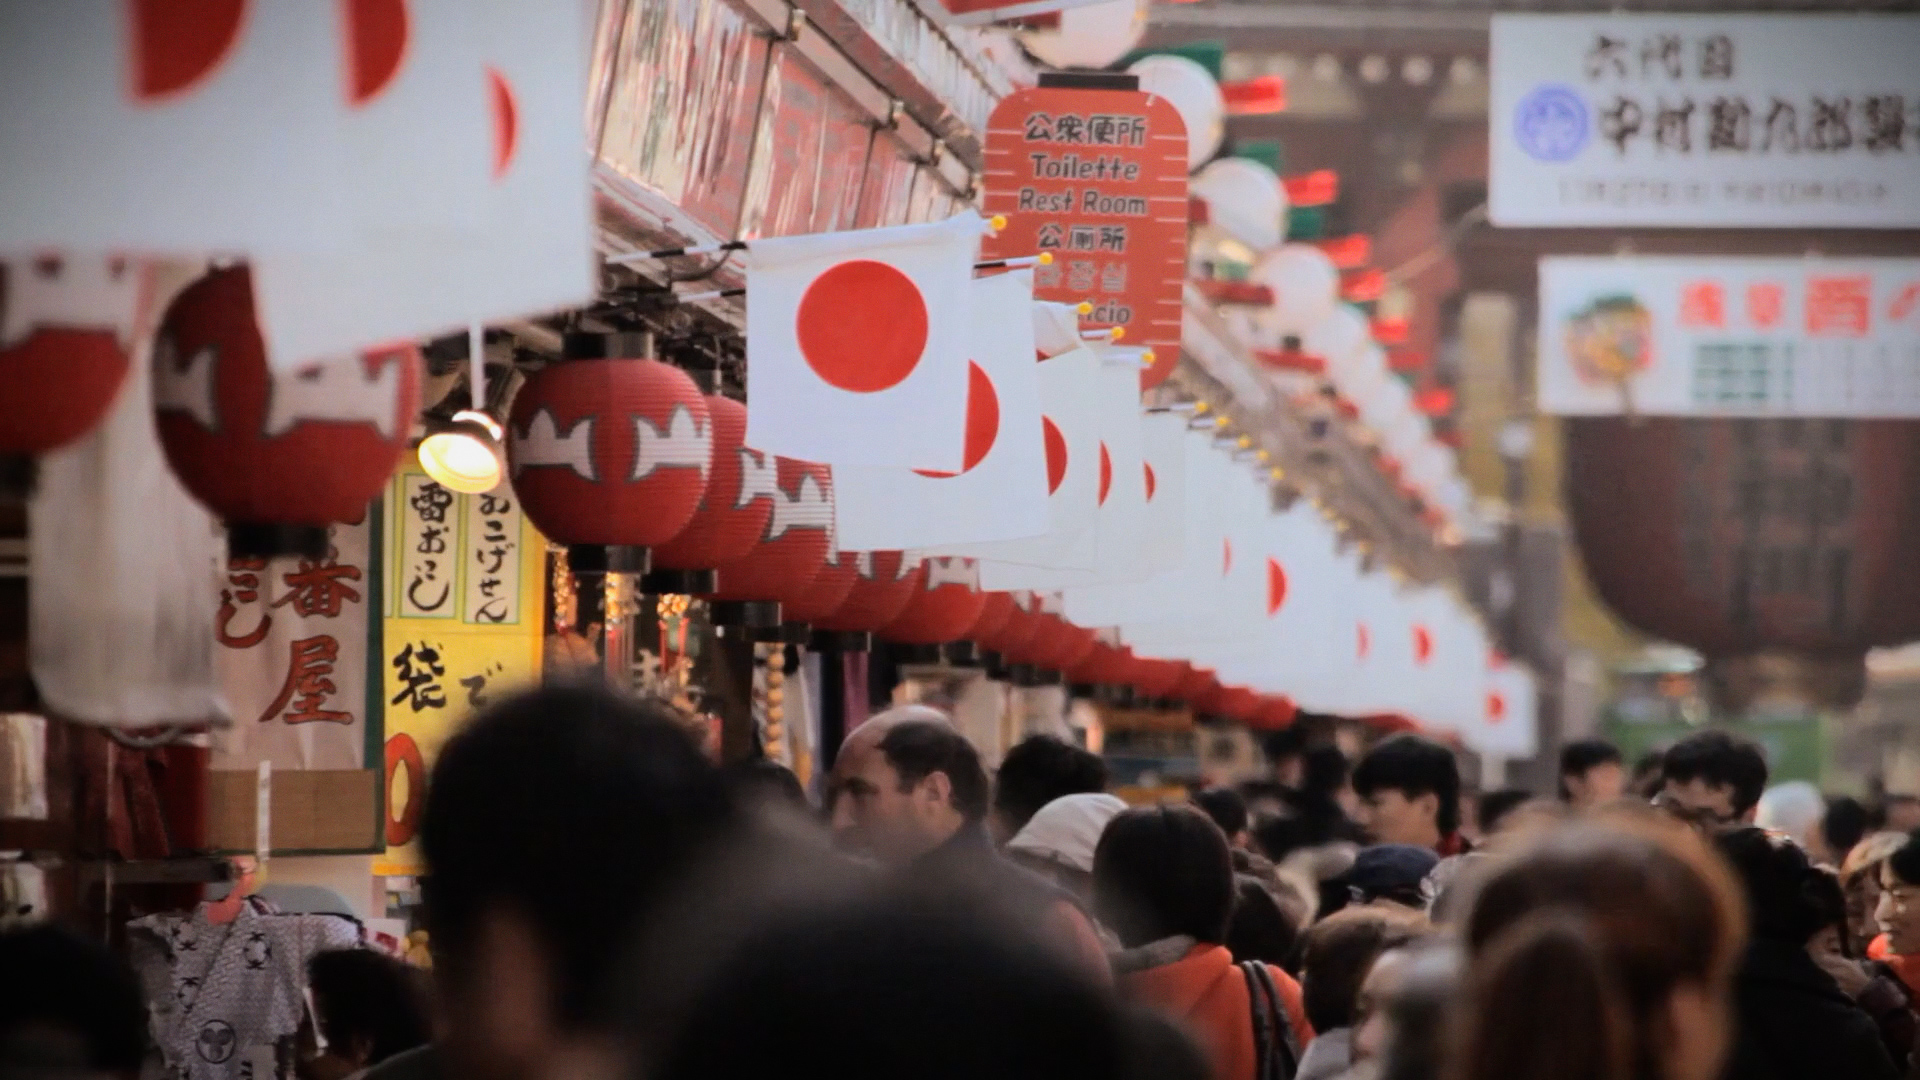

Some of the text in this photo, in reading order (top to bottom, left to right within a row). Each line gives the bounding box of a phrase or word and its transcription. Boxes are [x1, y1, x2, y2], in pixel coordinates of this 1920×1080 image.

[1023, 113, 1147, 145] 公衆便所
[1031, 154, 1139, 180] Toilette
[1019, 188, 1146, 215] Rest Room
[1081, 300, 1131, 323] icio
[409, 481, 453, 612] 雷おこし
[259, 505, 364, 724] 番屋
